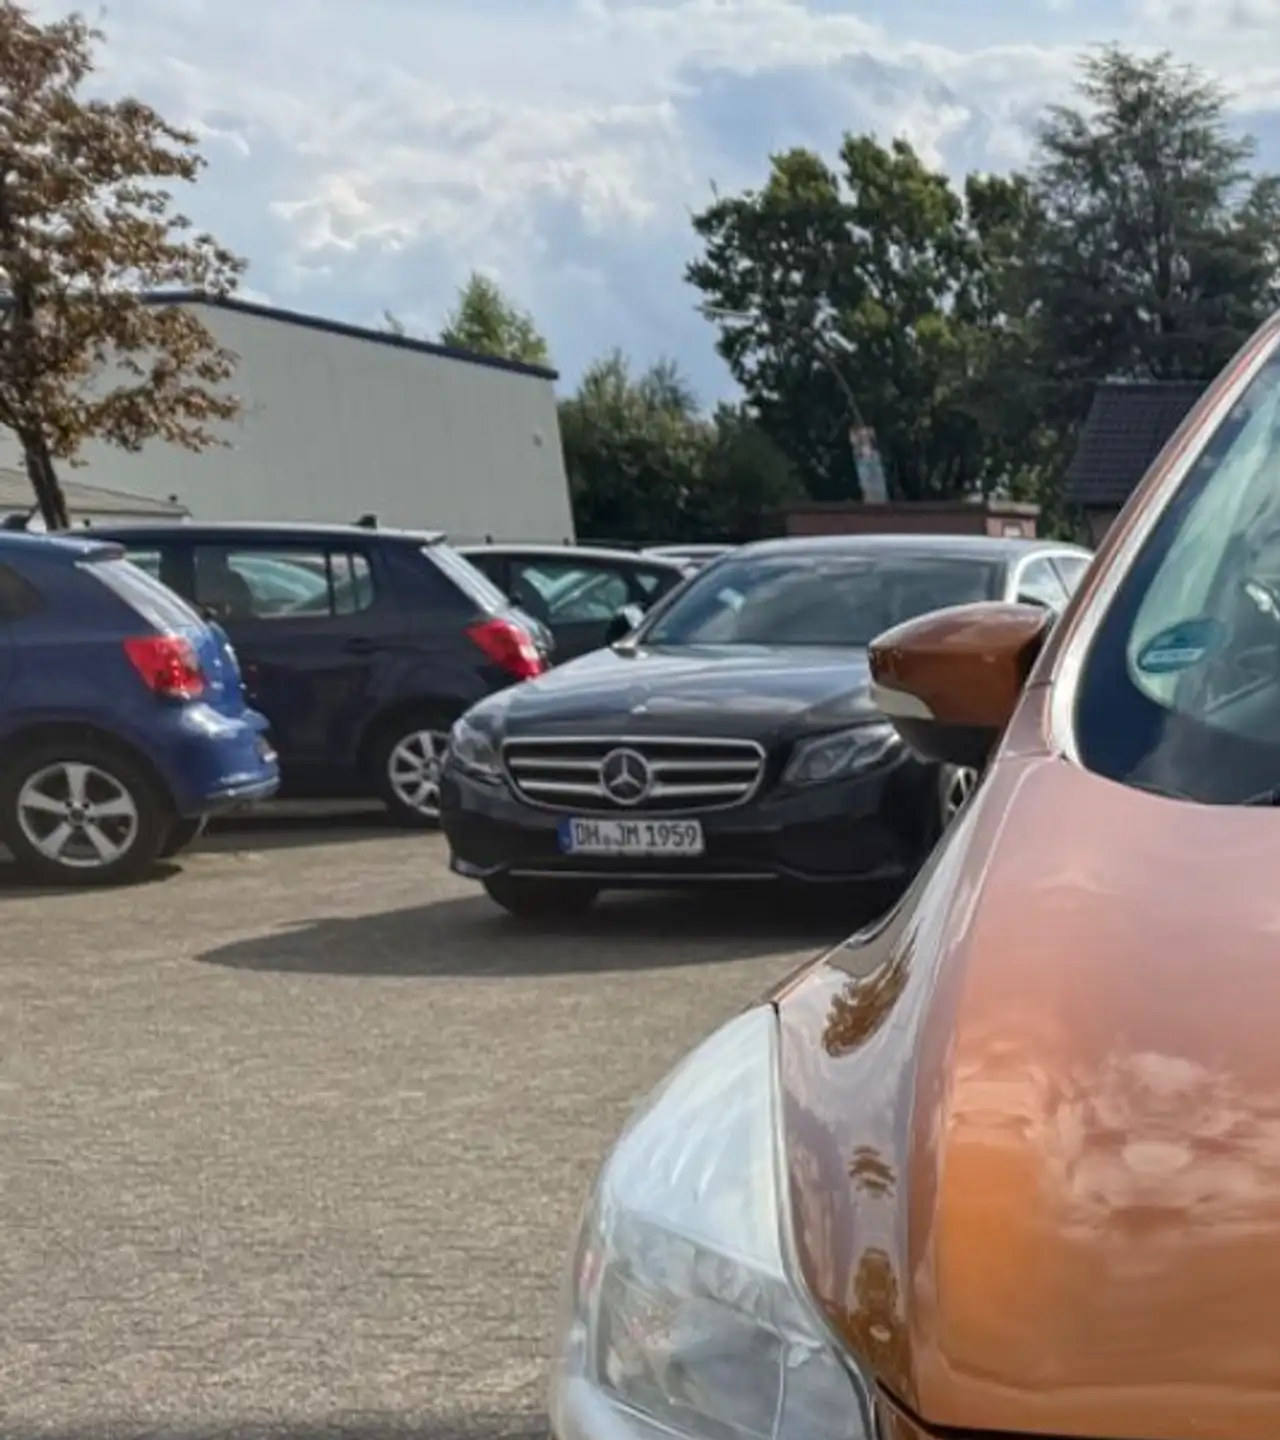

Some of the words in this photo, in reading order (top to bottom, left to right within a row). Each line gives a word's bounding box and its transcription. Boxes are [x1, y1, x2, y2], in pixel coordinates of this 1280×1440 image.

[574, 822, 601, 847] DH
[614, 822, 641, 848] JM
[644, 822, 699, 848] 1959
